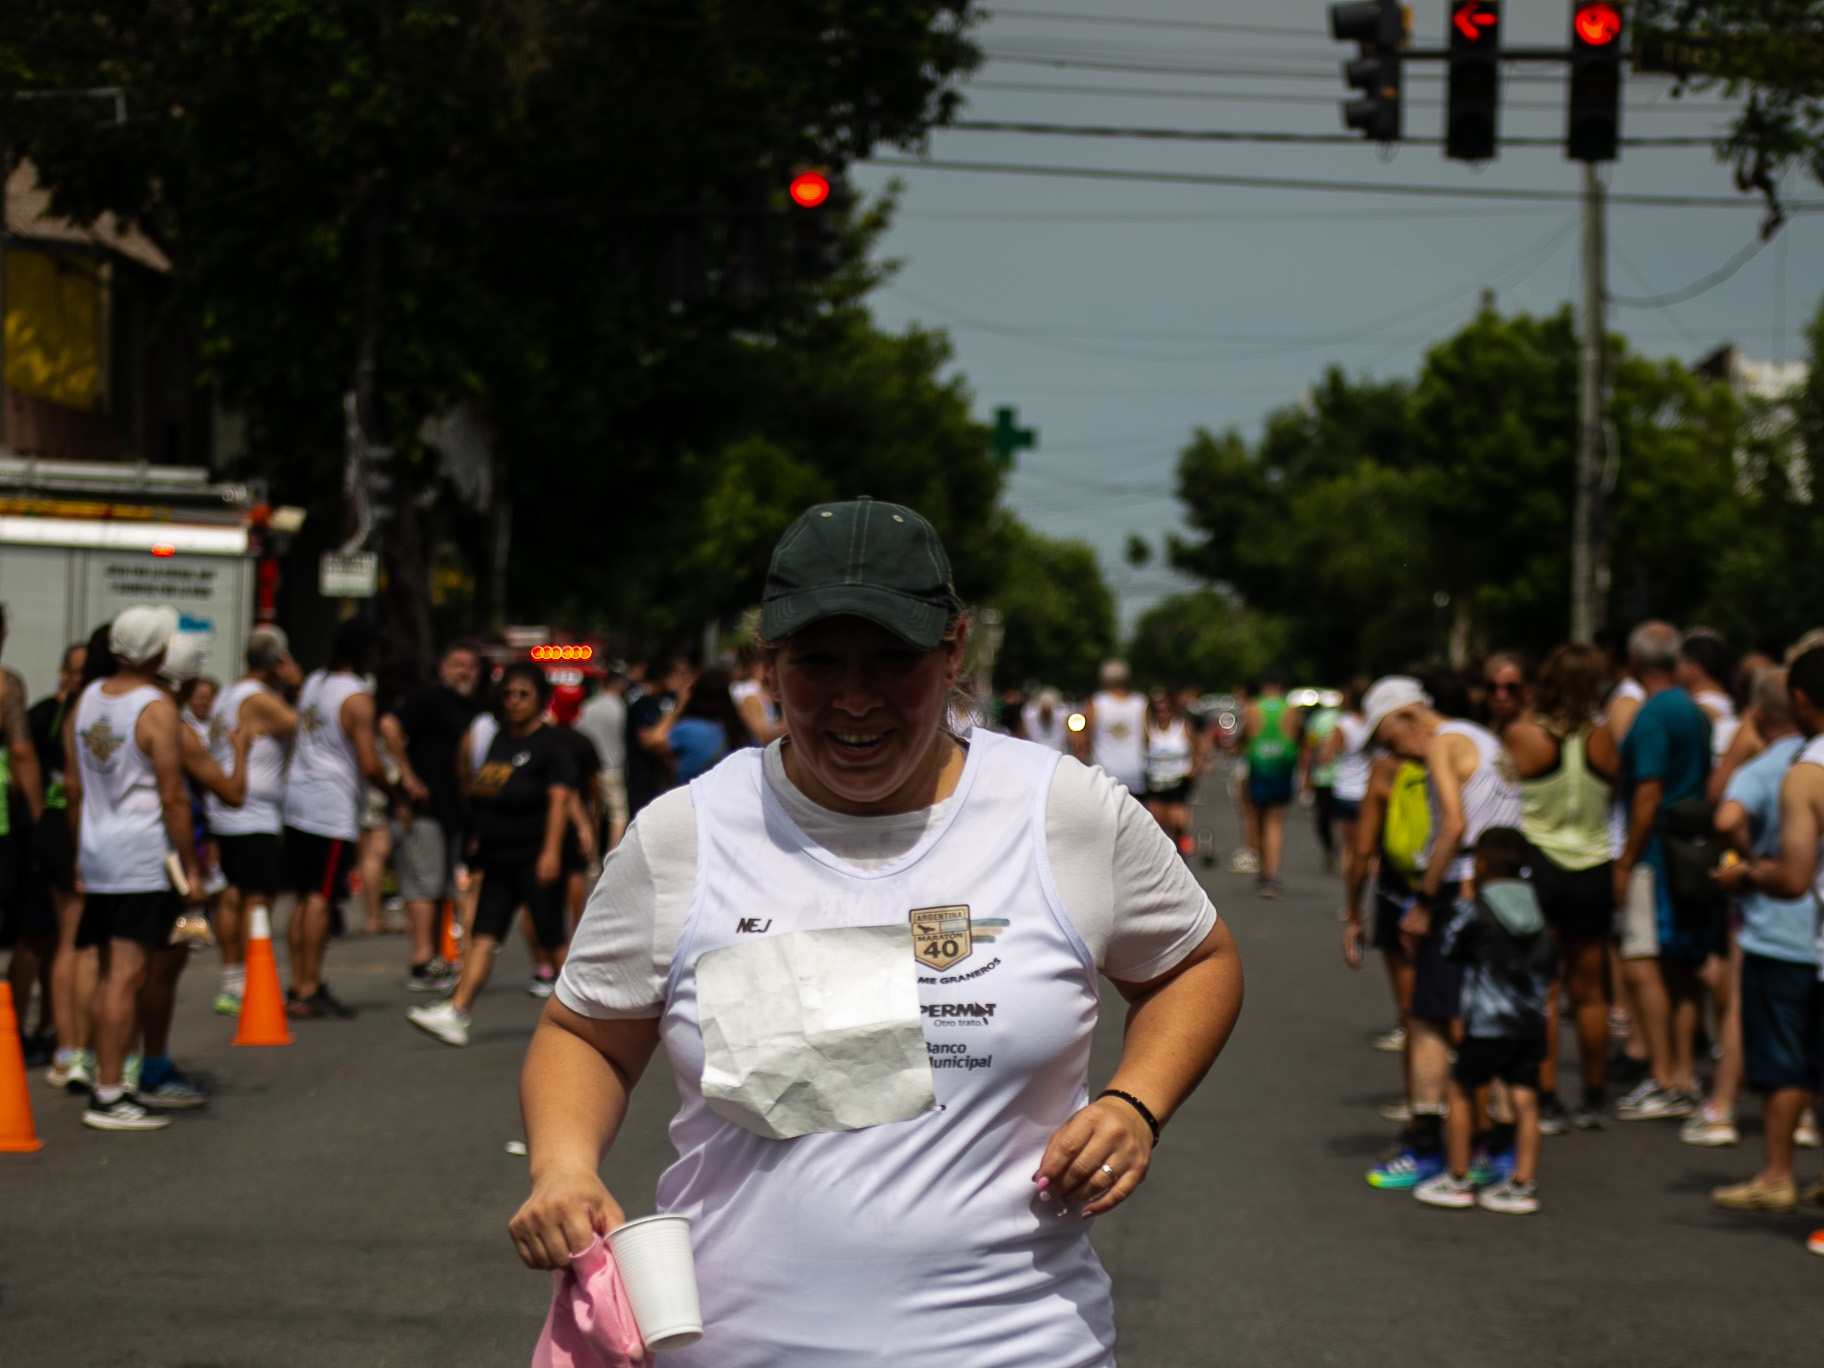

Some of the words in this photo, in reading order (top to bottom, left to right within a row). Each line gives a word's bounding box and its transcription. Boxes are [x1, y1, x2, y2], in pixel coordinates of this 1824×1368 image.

[916, 911, 963, 922] ARGENTINA
[735, 917, 773, 934] NEJ
[917, 932, 963, 942] MARATÓN
[923, 940, 959, 959] 40
[939, 957, 1002, 985] GRANEROS
[933, 1019, 956, 1028] Otro
